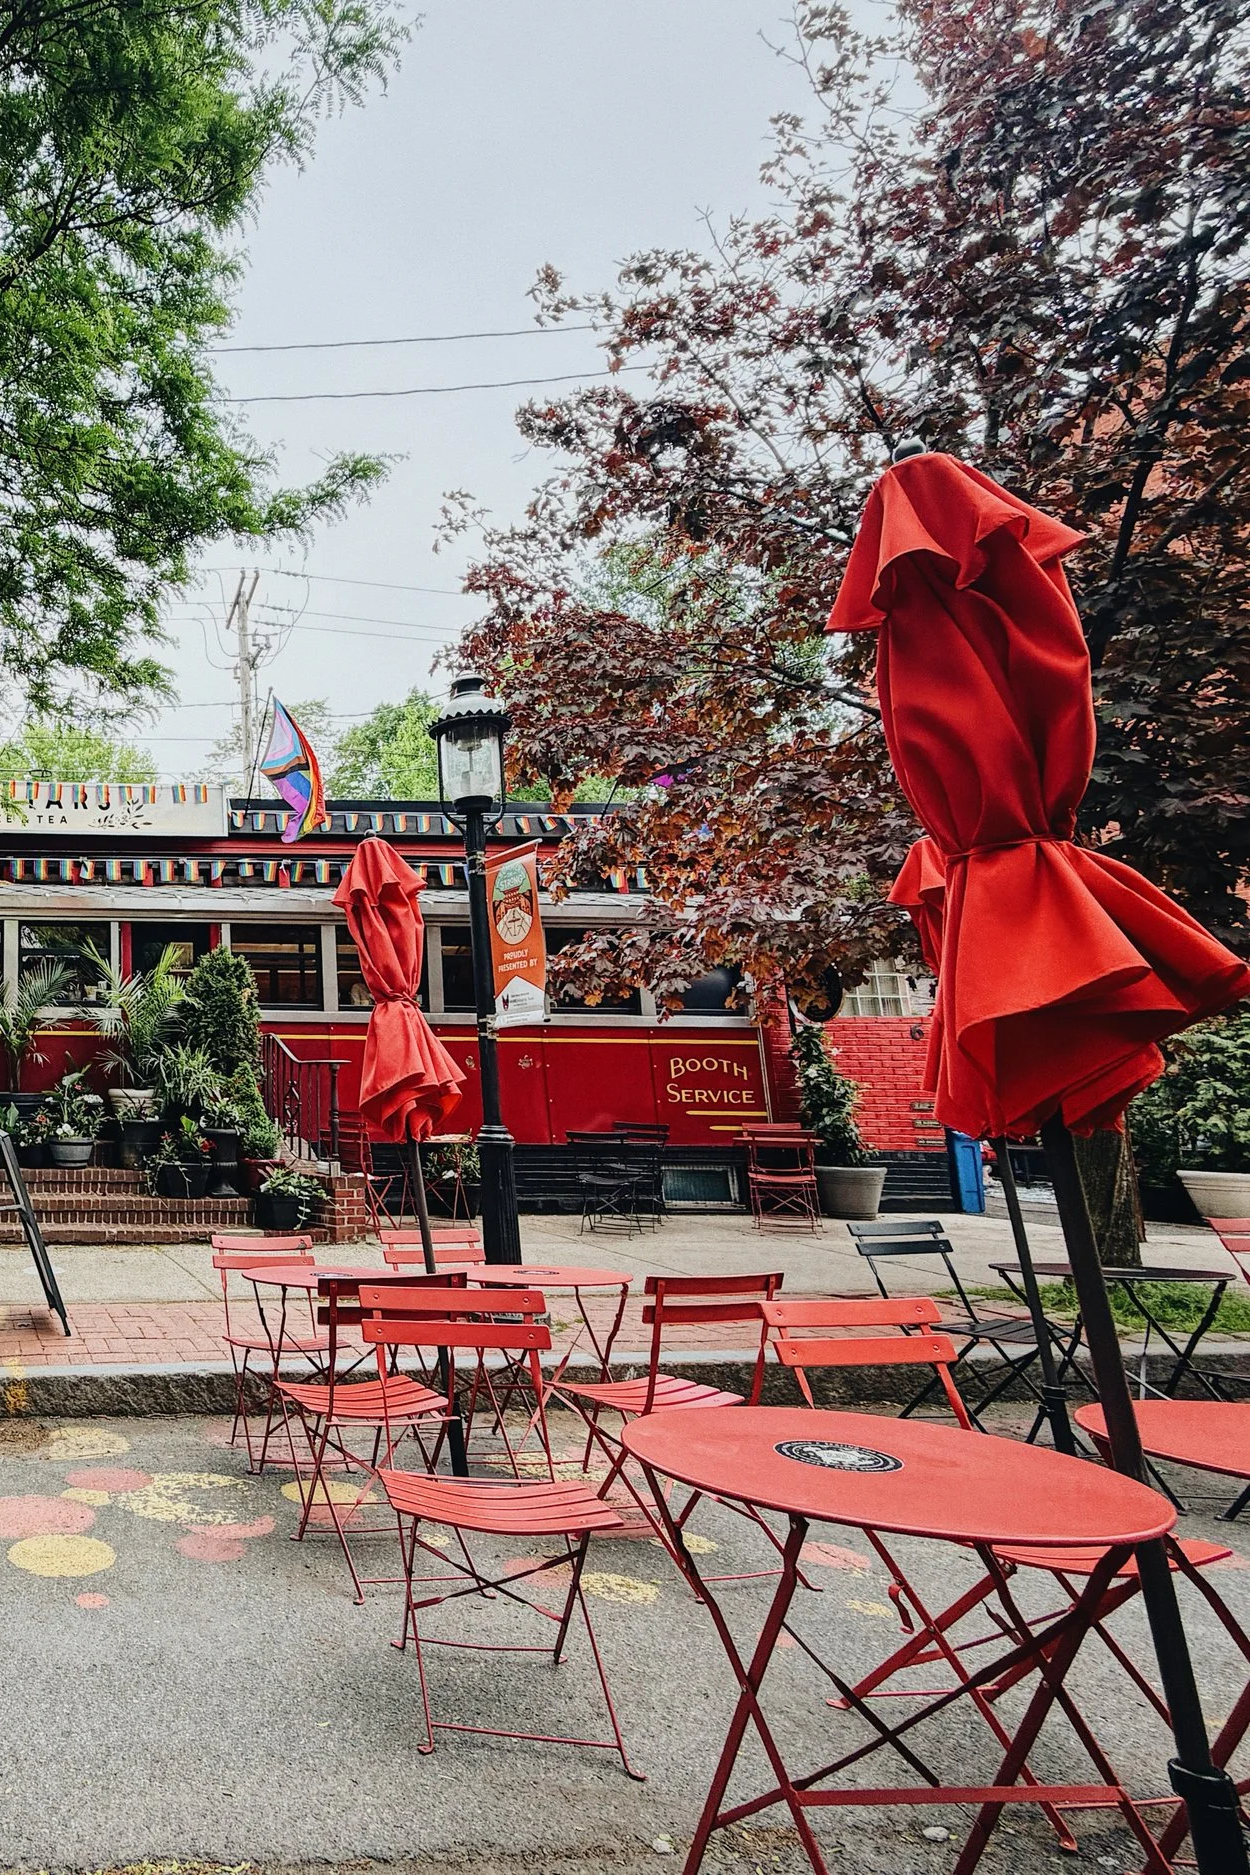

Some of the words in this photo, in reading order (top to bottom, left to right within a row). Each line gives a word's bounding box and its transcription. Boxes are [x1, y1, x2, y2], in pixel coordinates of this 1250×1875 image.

[36, 814, 68, 825] TEA
[503, 948, 529, 961] PROUDLY
[498, 960, 528, 973] PRESENTED
[529, 958, 538, 967] BY
[910, 1024, 925, 1041] 6
[669, 1057, 748, 1081] BOOTH
[666, 1083, 756, 1104] SERVICE
